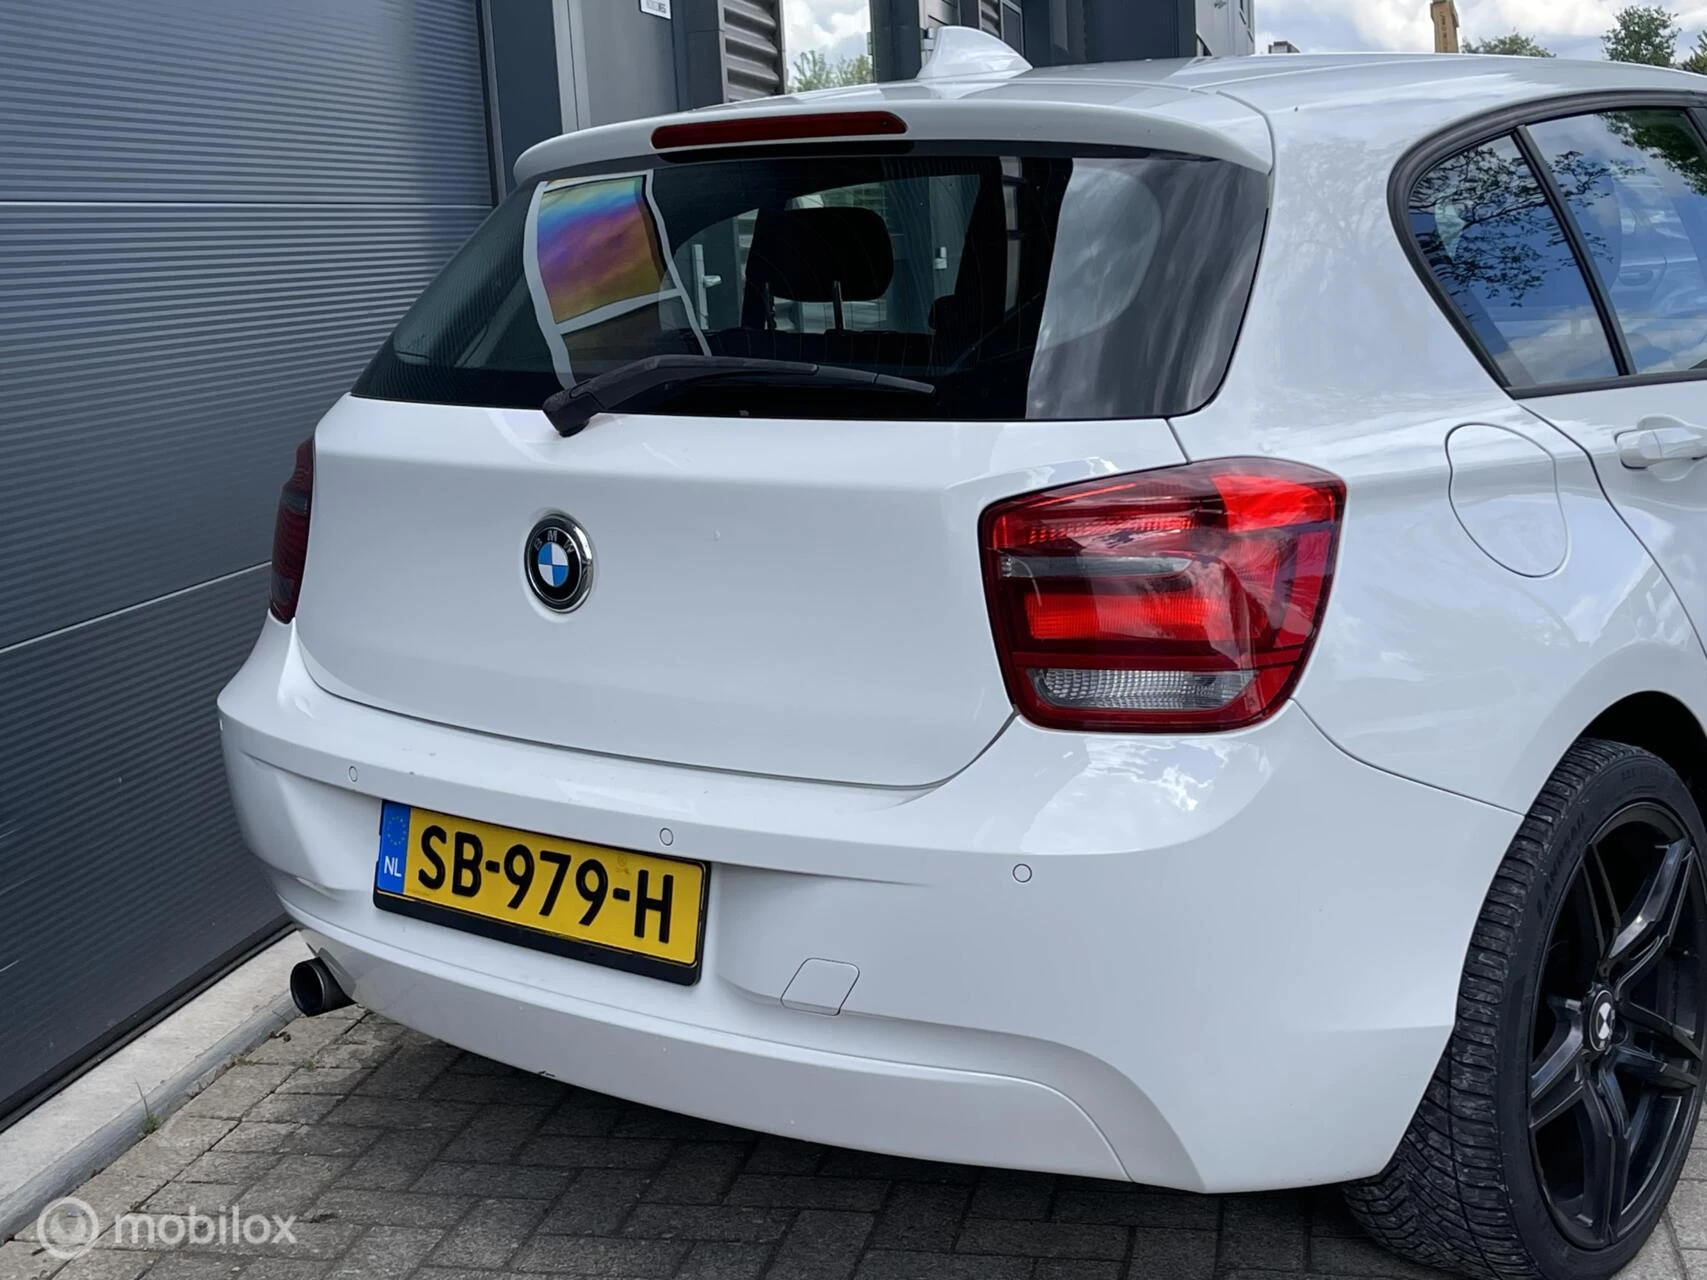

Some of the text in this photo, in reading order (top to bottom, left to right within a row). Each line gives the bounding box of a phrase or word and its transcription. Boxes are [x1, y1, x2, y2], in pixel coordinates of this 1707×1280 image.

[533, 529, 575, 554] BMW
[384, 855, 402, 877] NL
[417, 825, 674, 944] SB-979-H
